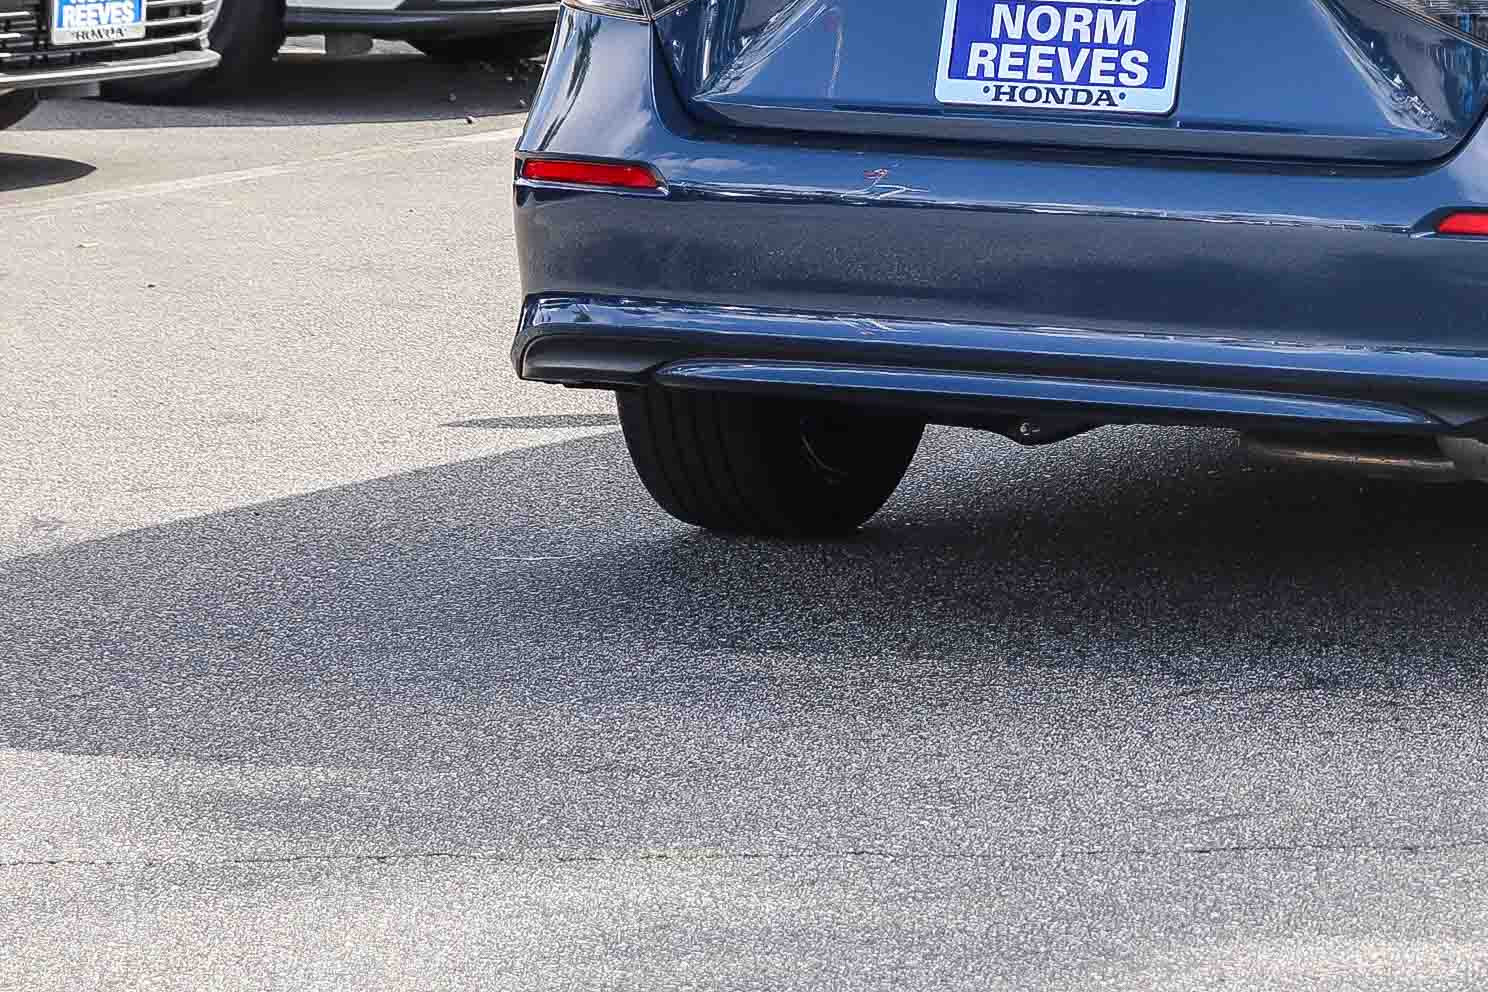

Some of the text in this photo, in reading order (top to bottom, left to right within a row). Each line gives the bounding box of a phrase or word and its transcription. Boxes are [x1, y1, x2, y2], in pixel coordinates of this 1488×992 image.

[62, 0, 135, 27] REEVES
[990, 3, 1137, 46] NORM
[966, 42, 1150, 87] REEVES
[991, 85, 1119, 106] HONDA
